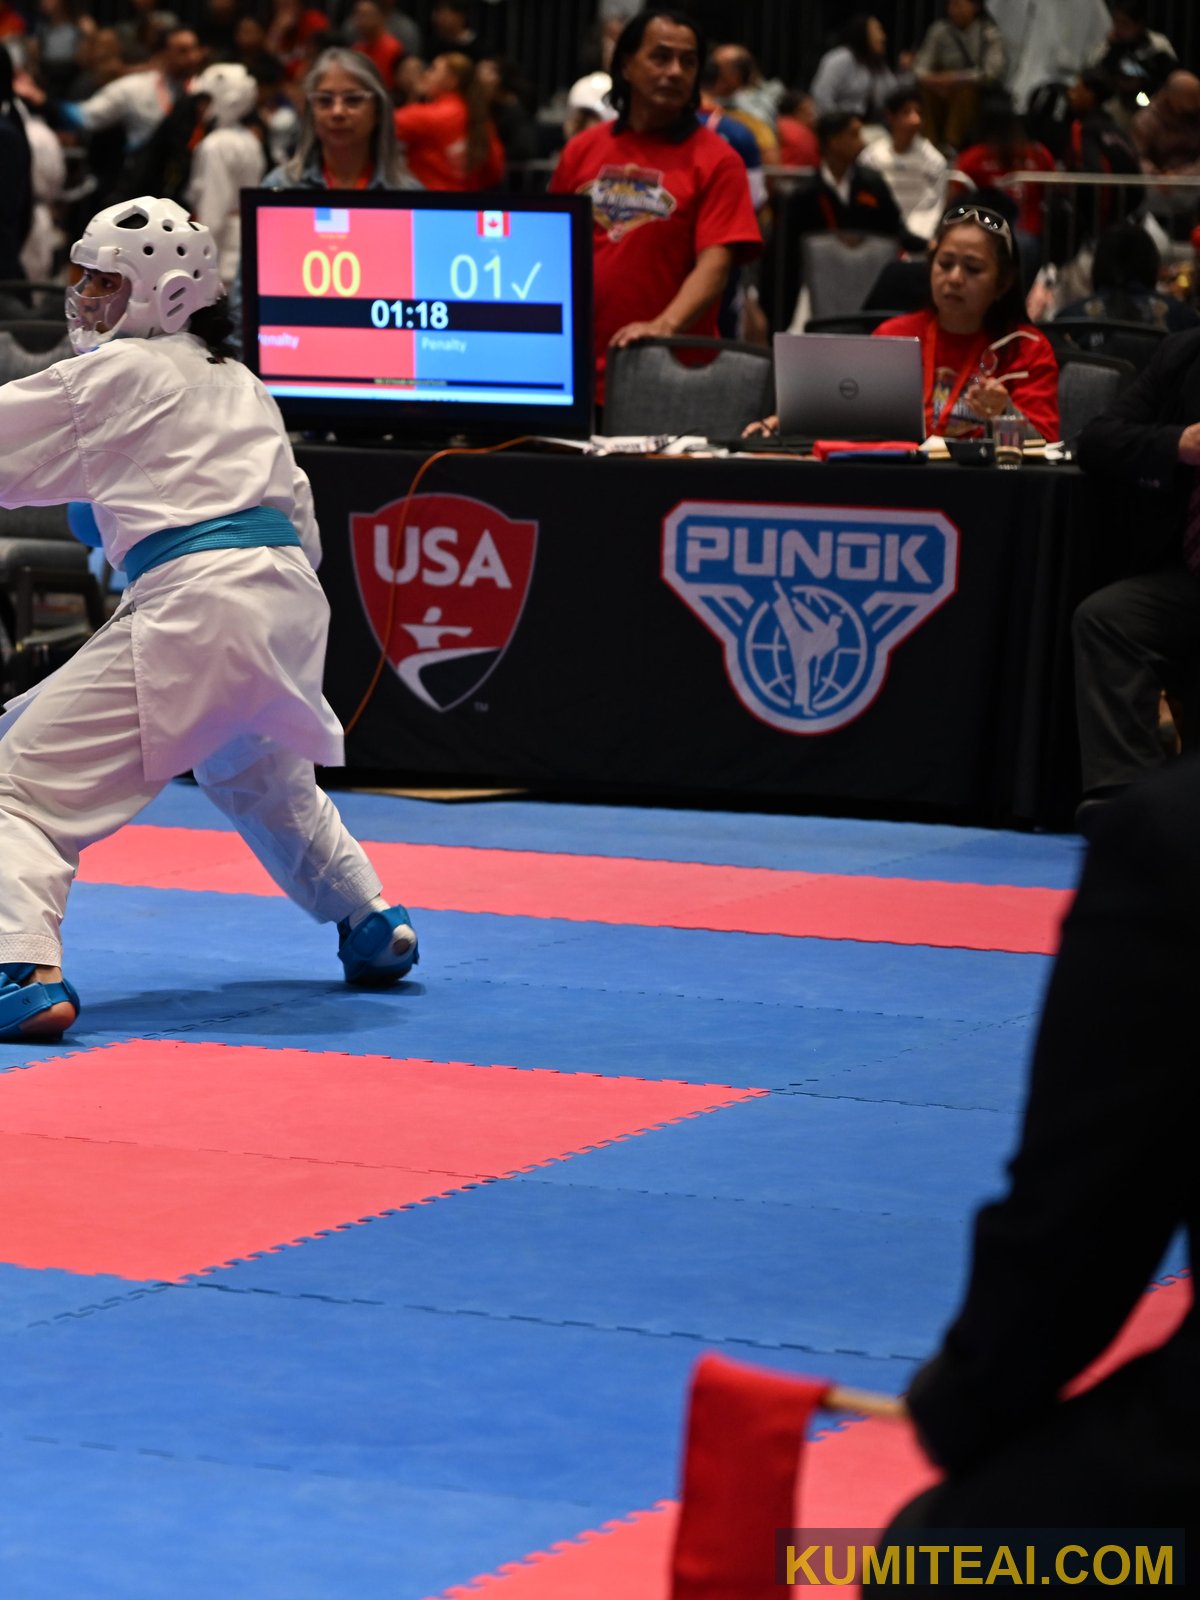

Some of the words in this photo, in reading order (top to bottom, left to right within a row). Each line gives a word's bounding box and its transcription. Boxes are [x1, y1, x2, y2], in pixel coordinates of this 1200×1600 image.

[302, 250, 361, 297] 00
[450, 254, 501, 300] 01
[371, 300, 449, 330] 01:18
[421, 336, 467, 353] Penalty
[373, 524, 513, 588] USA
[685, 525, 933, 584] PUNOK
